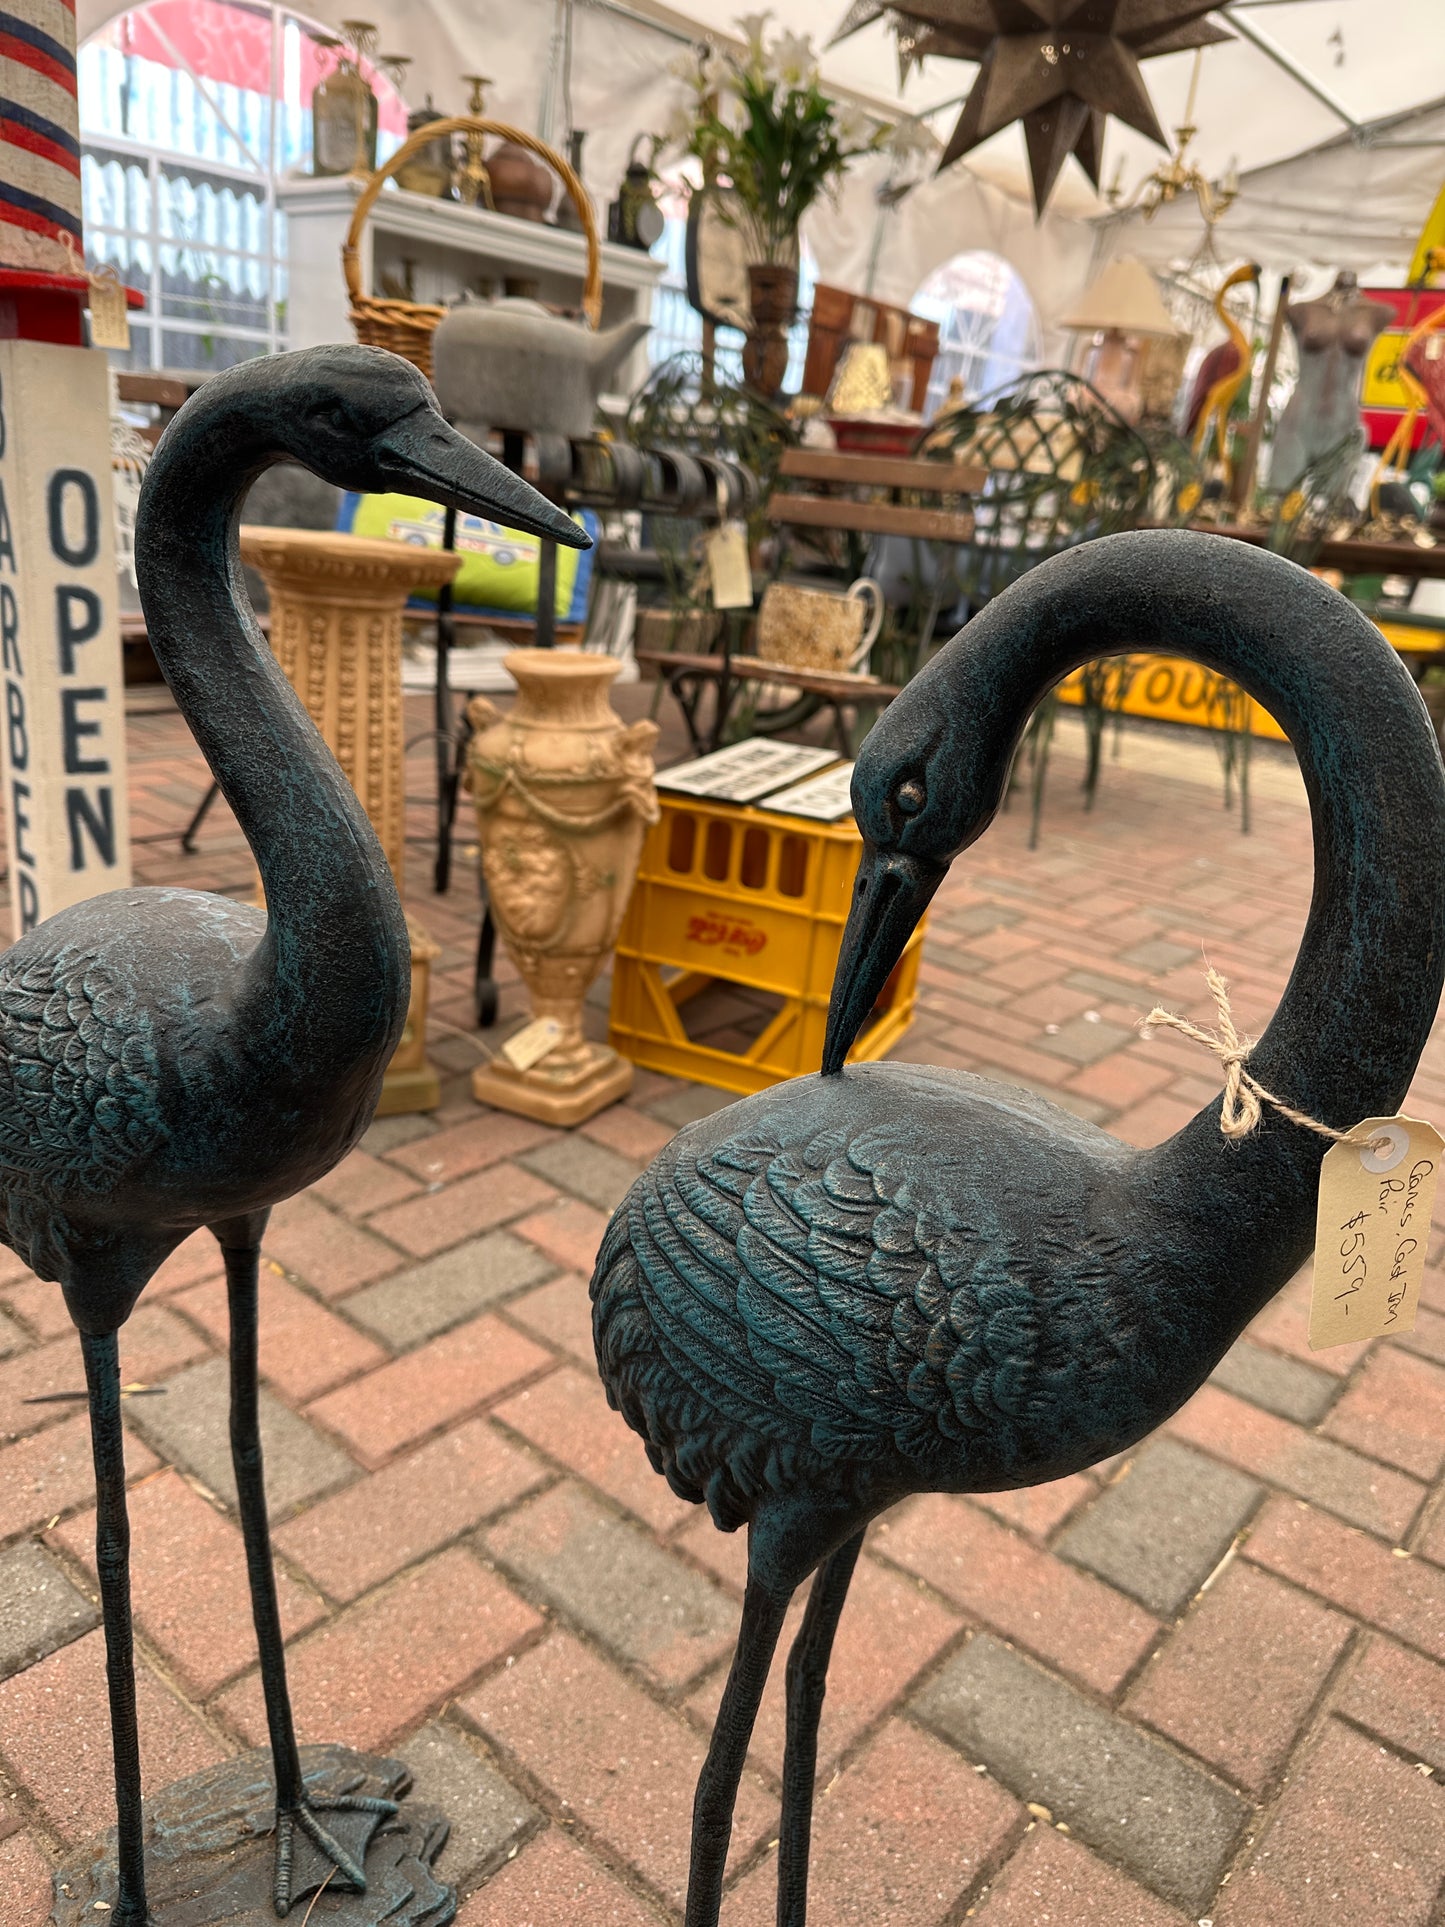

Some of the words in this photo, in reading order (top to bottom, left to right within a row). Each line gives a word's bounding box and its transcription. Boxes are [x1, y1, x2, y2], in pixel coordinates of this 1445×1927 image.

[0, 370, 39, 936] ARBER
[47, 468, 116, 871] OPEN
[1379, 1179, 1406, 1215] Pair
[1389, 1238, 1418, 1281] Cast
